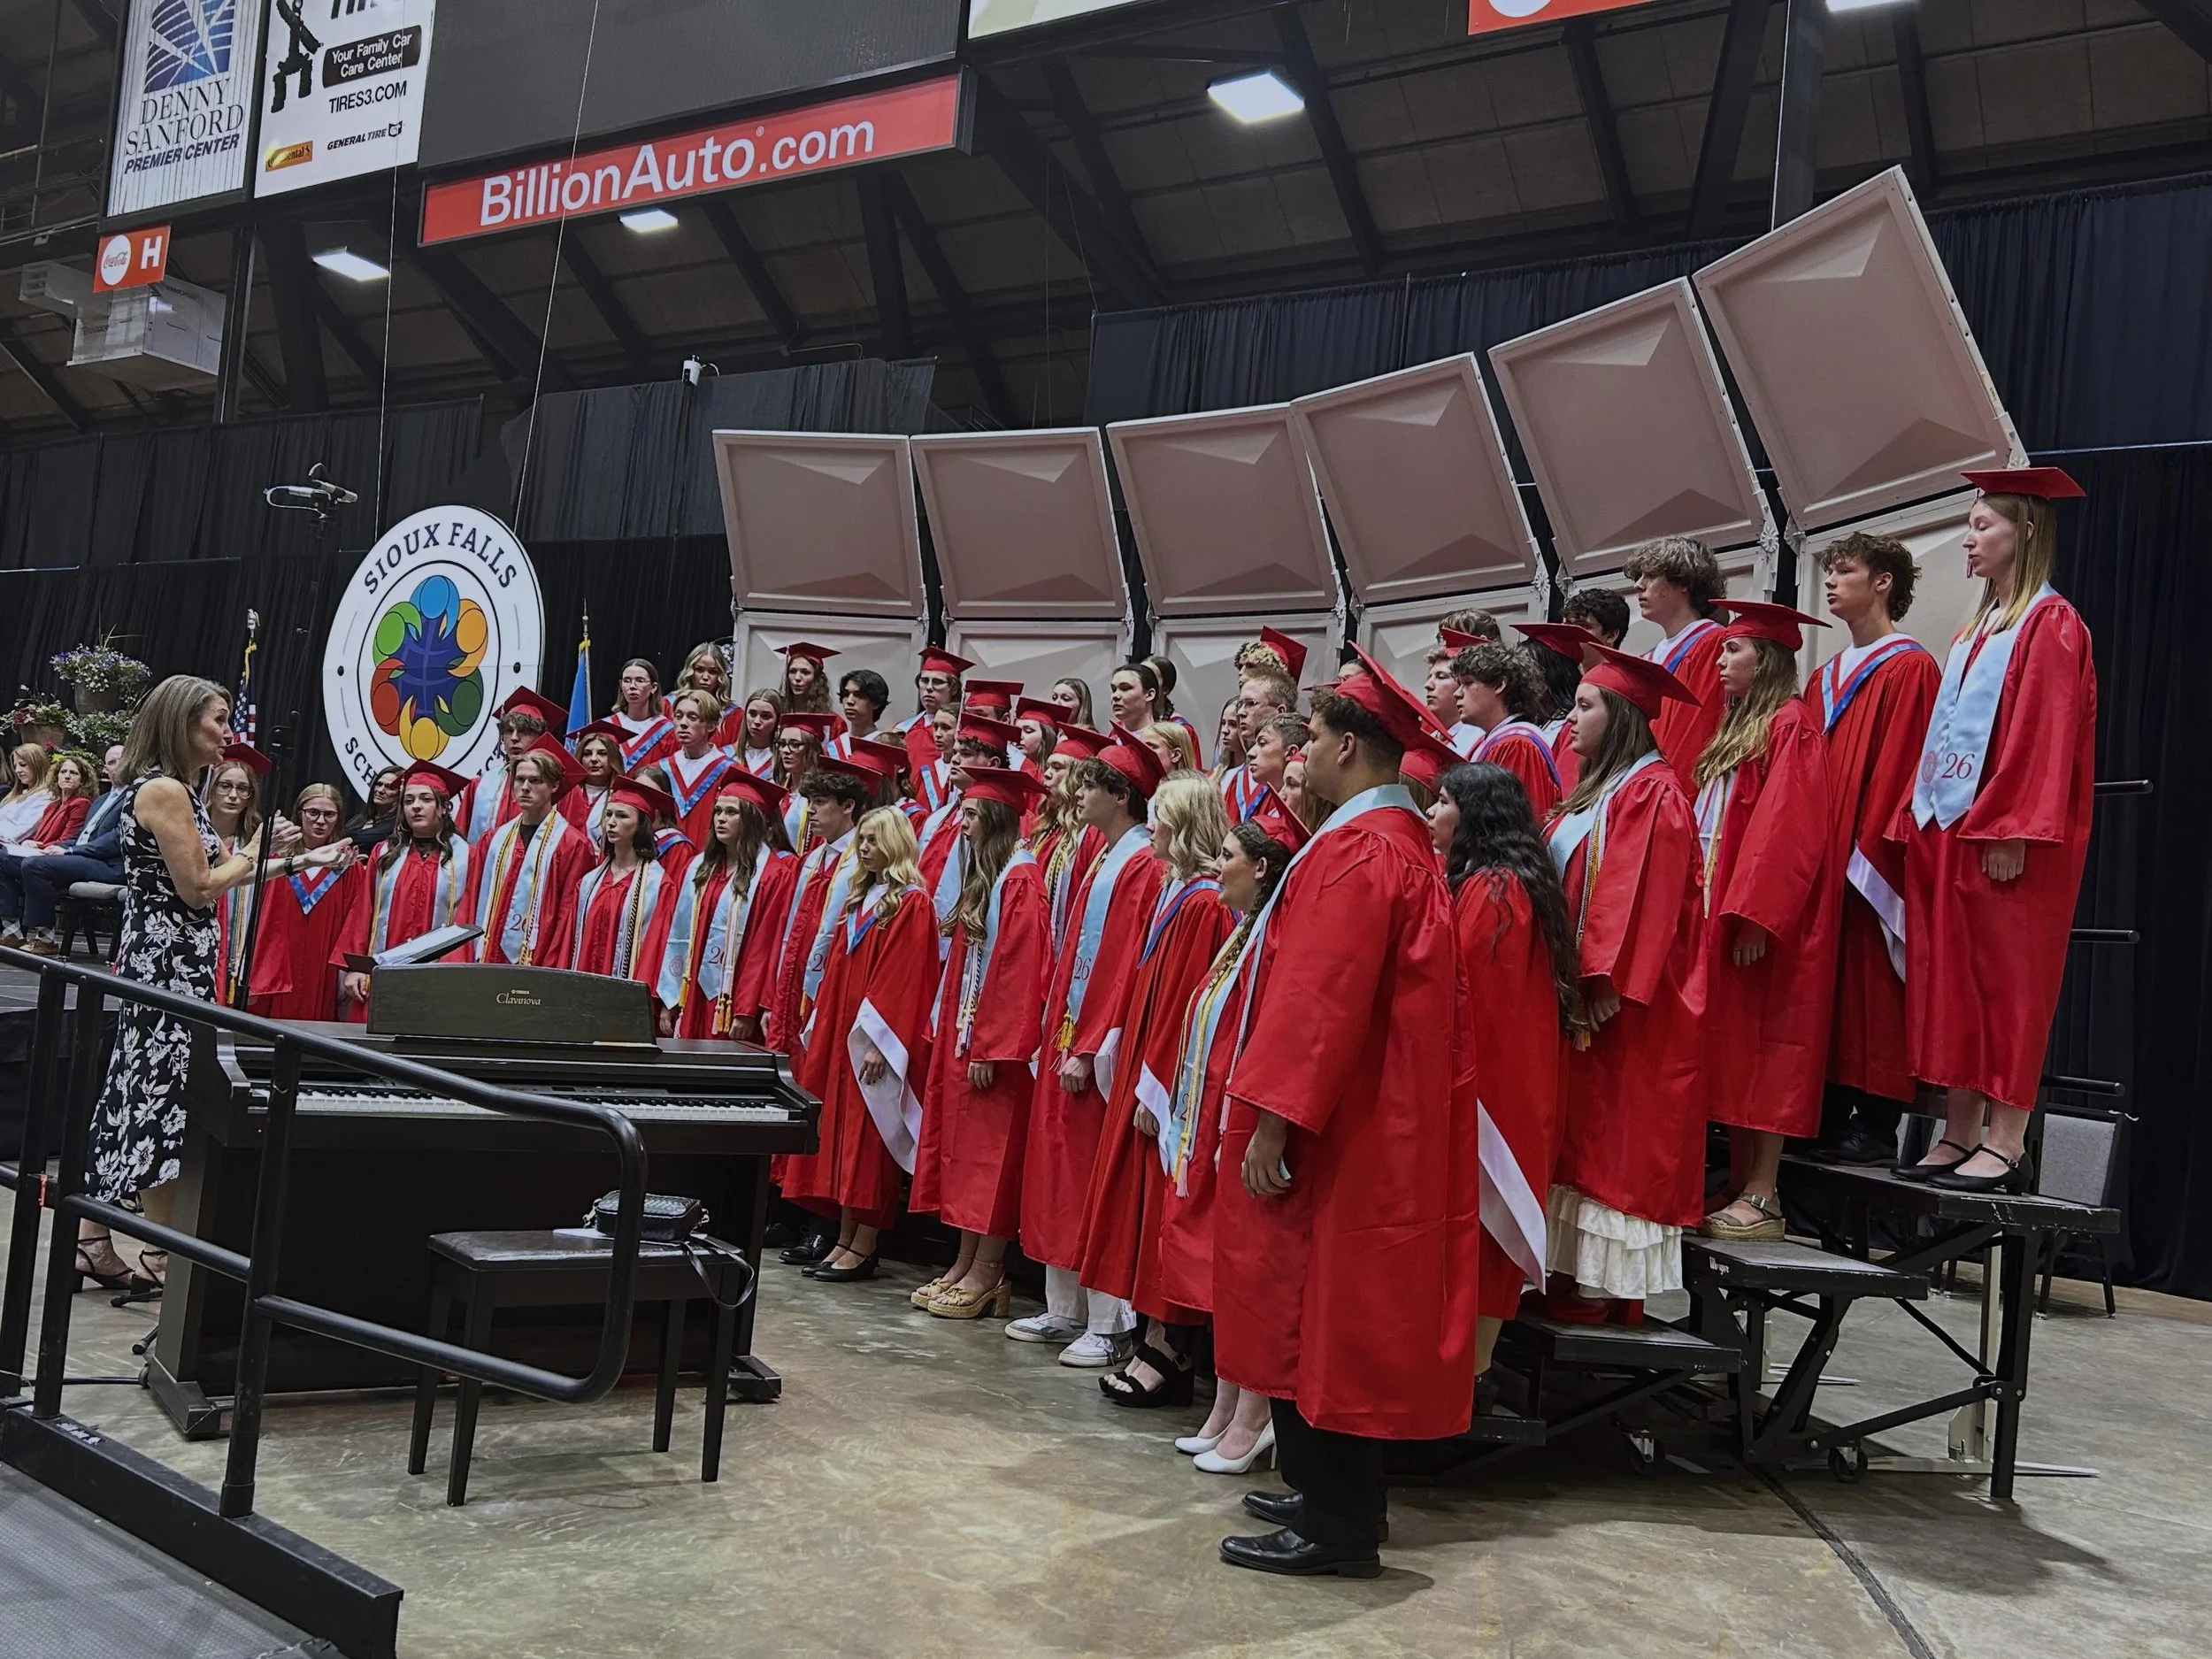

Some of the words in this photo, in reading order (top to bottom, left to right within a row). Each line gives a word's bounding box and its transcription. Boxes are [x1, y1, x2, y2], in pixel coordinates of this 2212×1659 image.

[332, 49, 354, 65] Your
[357, 38, 389, 58] Family
[392, 34, 412, 49] Car
[340, 62, 365, 78] Care
[367, 52, 403, 71] Center
[140, 78, 230, 125] DENNY
[329, 81, 407, 114] TIRES3.COM
[126, 104, 244, 156] SANFORD
[326, 135, 367, 150] GENERAL
[367, 127, 388, 141] TIRE
[124, 147, 182, 174] PREMIER
[185, 134, 240, 160] CENTER
[140, 235, 163, 270] H
[363, 522, 441, 595] SIOUX
[448, 522, 518, 588] FALLS
[1940, 752, 1976, 780] 26
[1073, 956, 1092, 980] 26
[495, 992, 541, 1006] Clavinova
